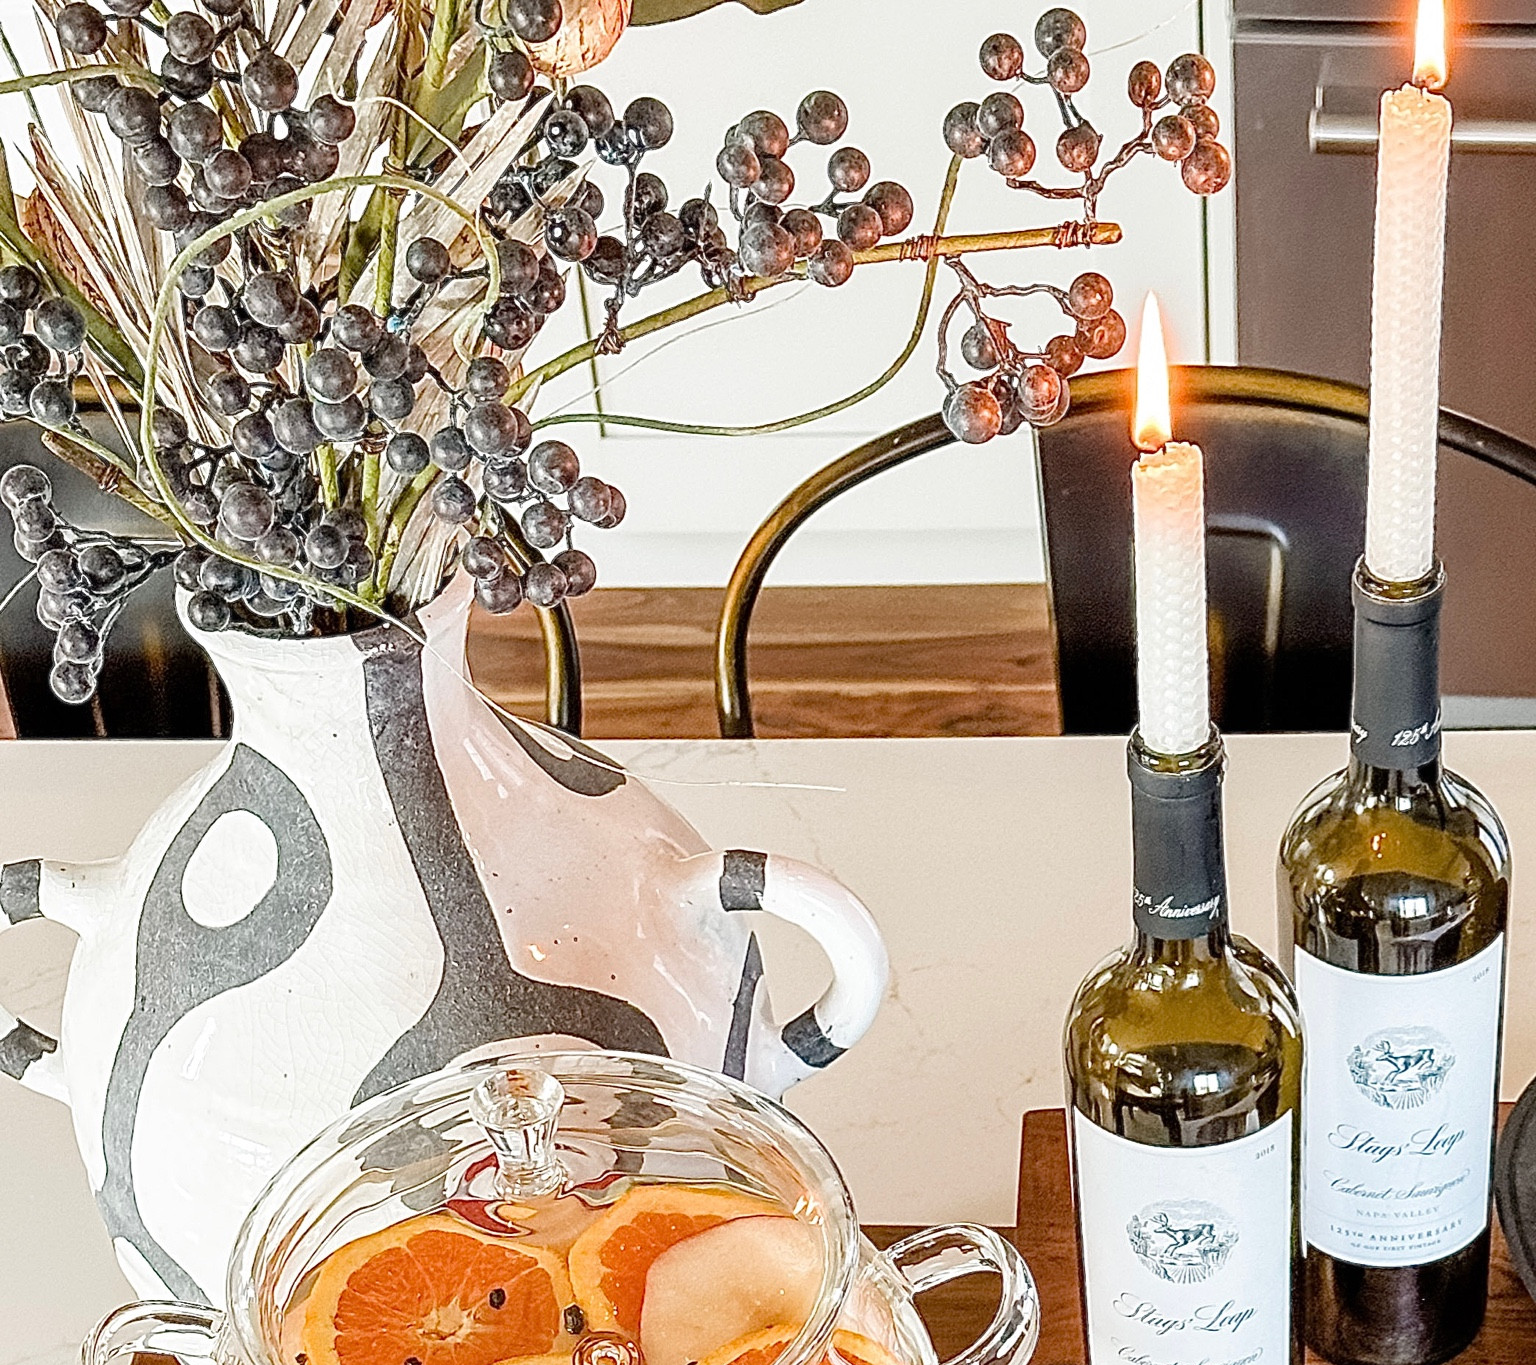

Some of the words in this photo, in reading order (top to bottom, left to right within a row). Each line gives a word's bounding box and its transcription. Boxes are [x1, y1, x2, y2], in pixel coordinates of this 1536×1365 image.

[1148, 895, 1221, 920] Anniversary
[1408, 1123, 1468, 1156] Leap
[1323, 1169, 1394, 1200] Cabernet
[1395, 1168, 1471, 1200] Sauvignon
[1355, 1208, 1388, 1219] NAPA
[1393, 1205, 1440, 1219] VALLEY
[1369, 1218, 1463, 1243] ANNIVERSARY
[1193, 1299, 1259, 1334] Leap
